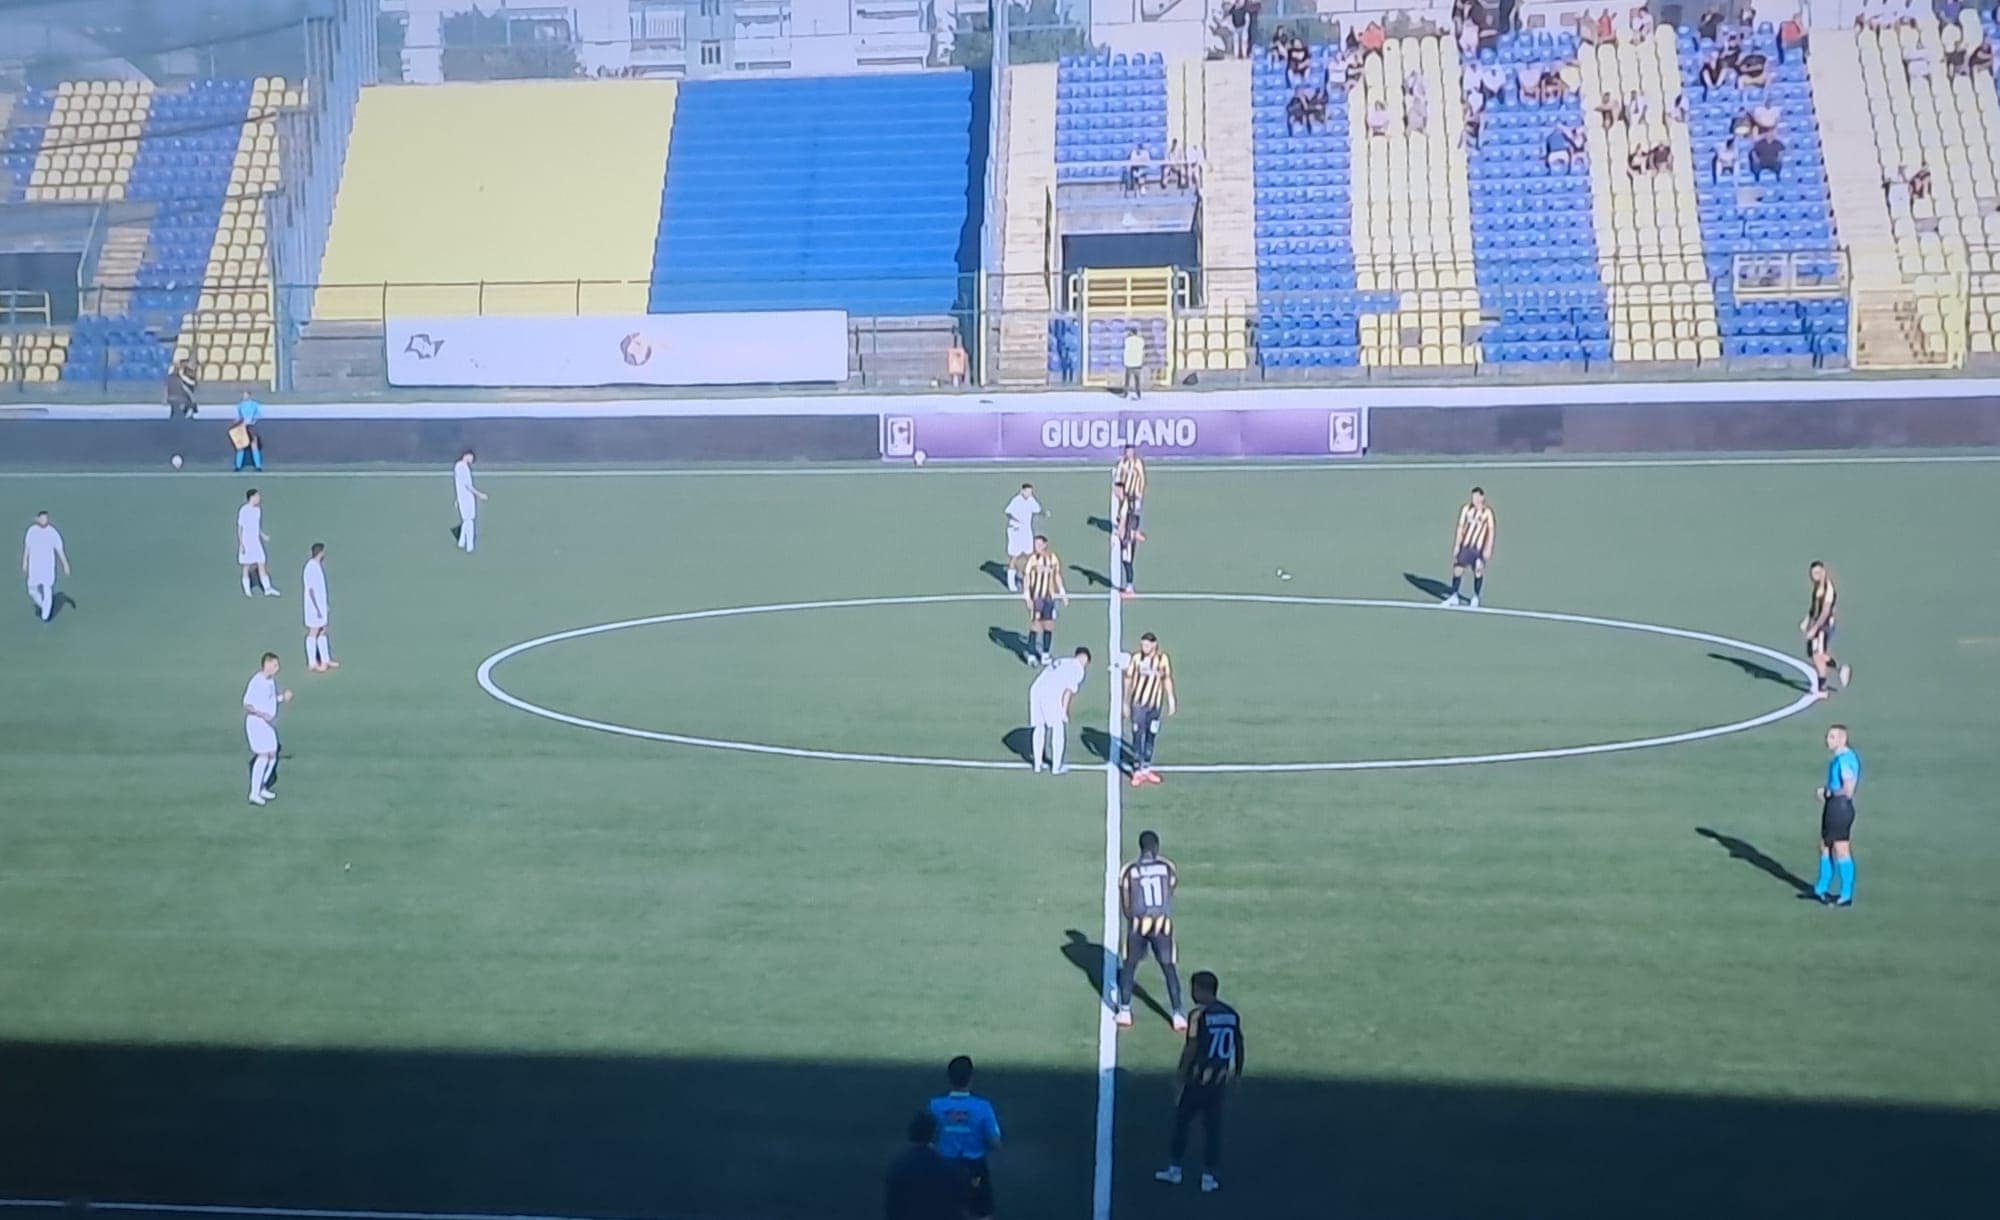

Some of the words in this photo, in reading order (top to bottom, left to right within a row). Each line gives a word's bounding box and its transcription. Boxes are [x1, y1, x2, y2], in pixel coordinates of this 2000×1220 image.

[1041, 418, 1197, 448] GIUGLIANO
[1140, 876, 1163, 907] 11
[1208, 1027, 1235, 1059] 70
